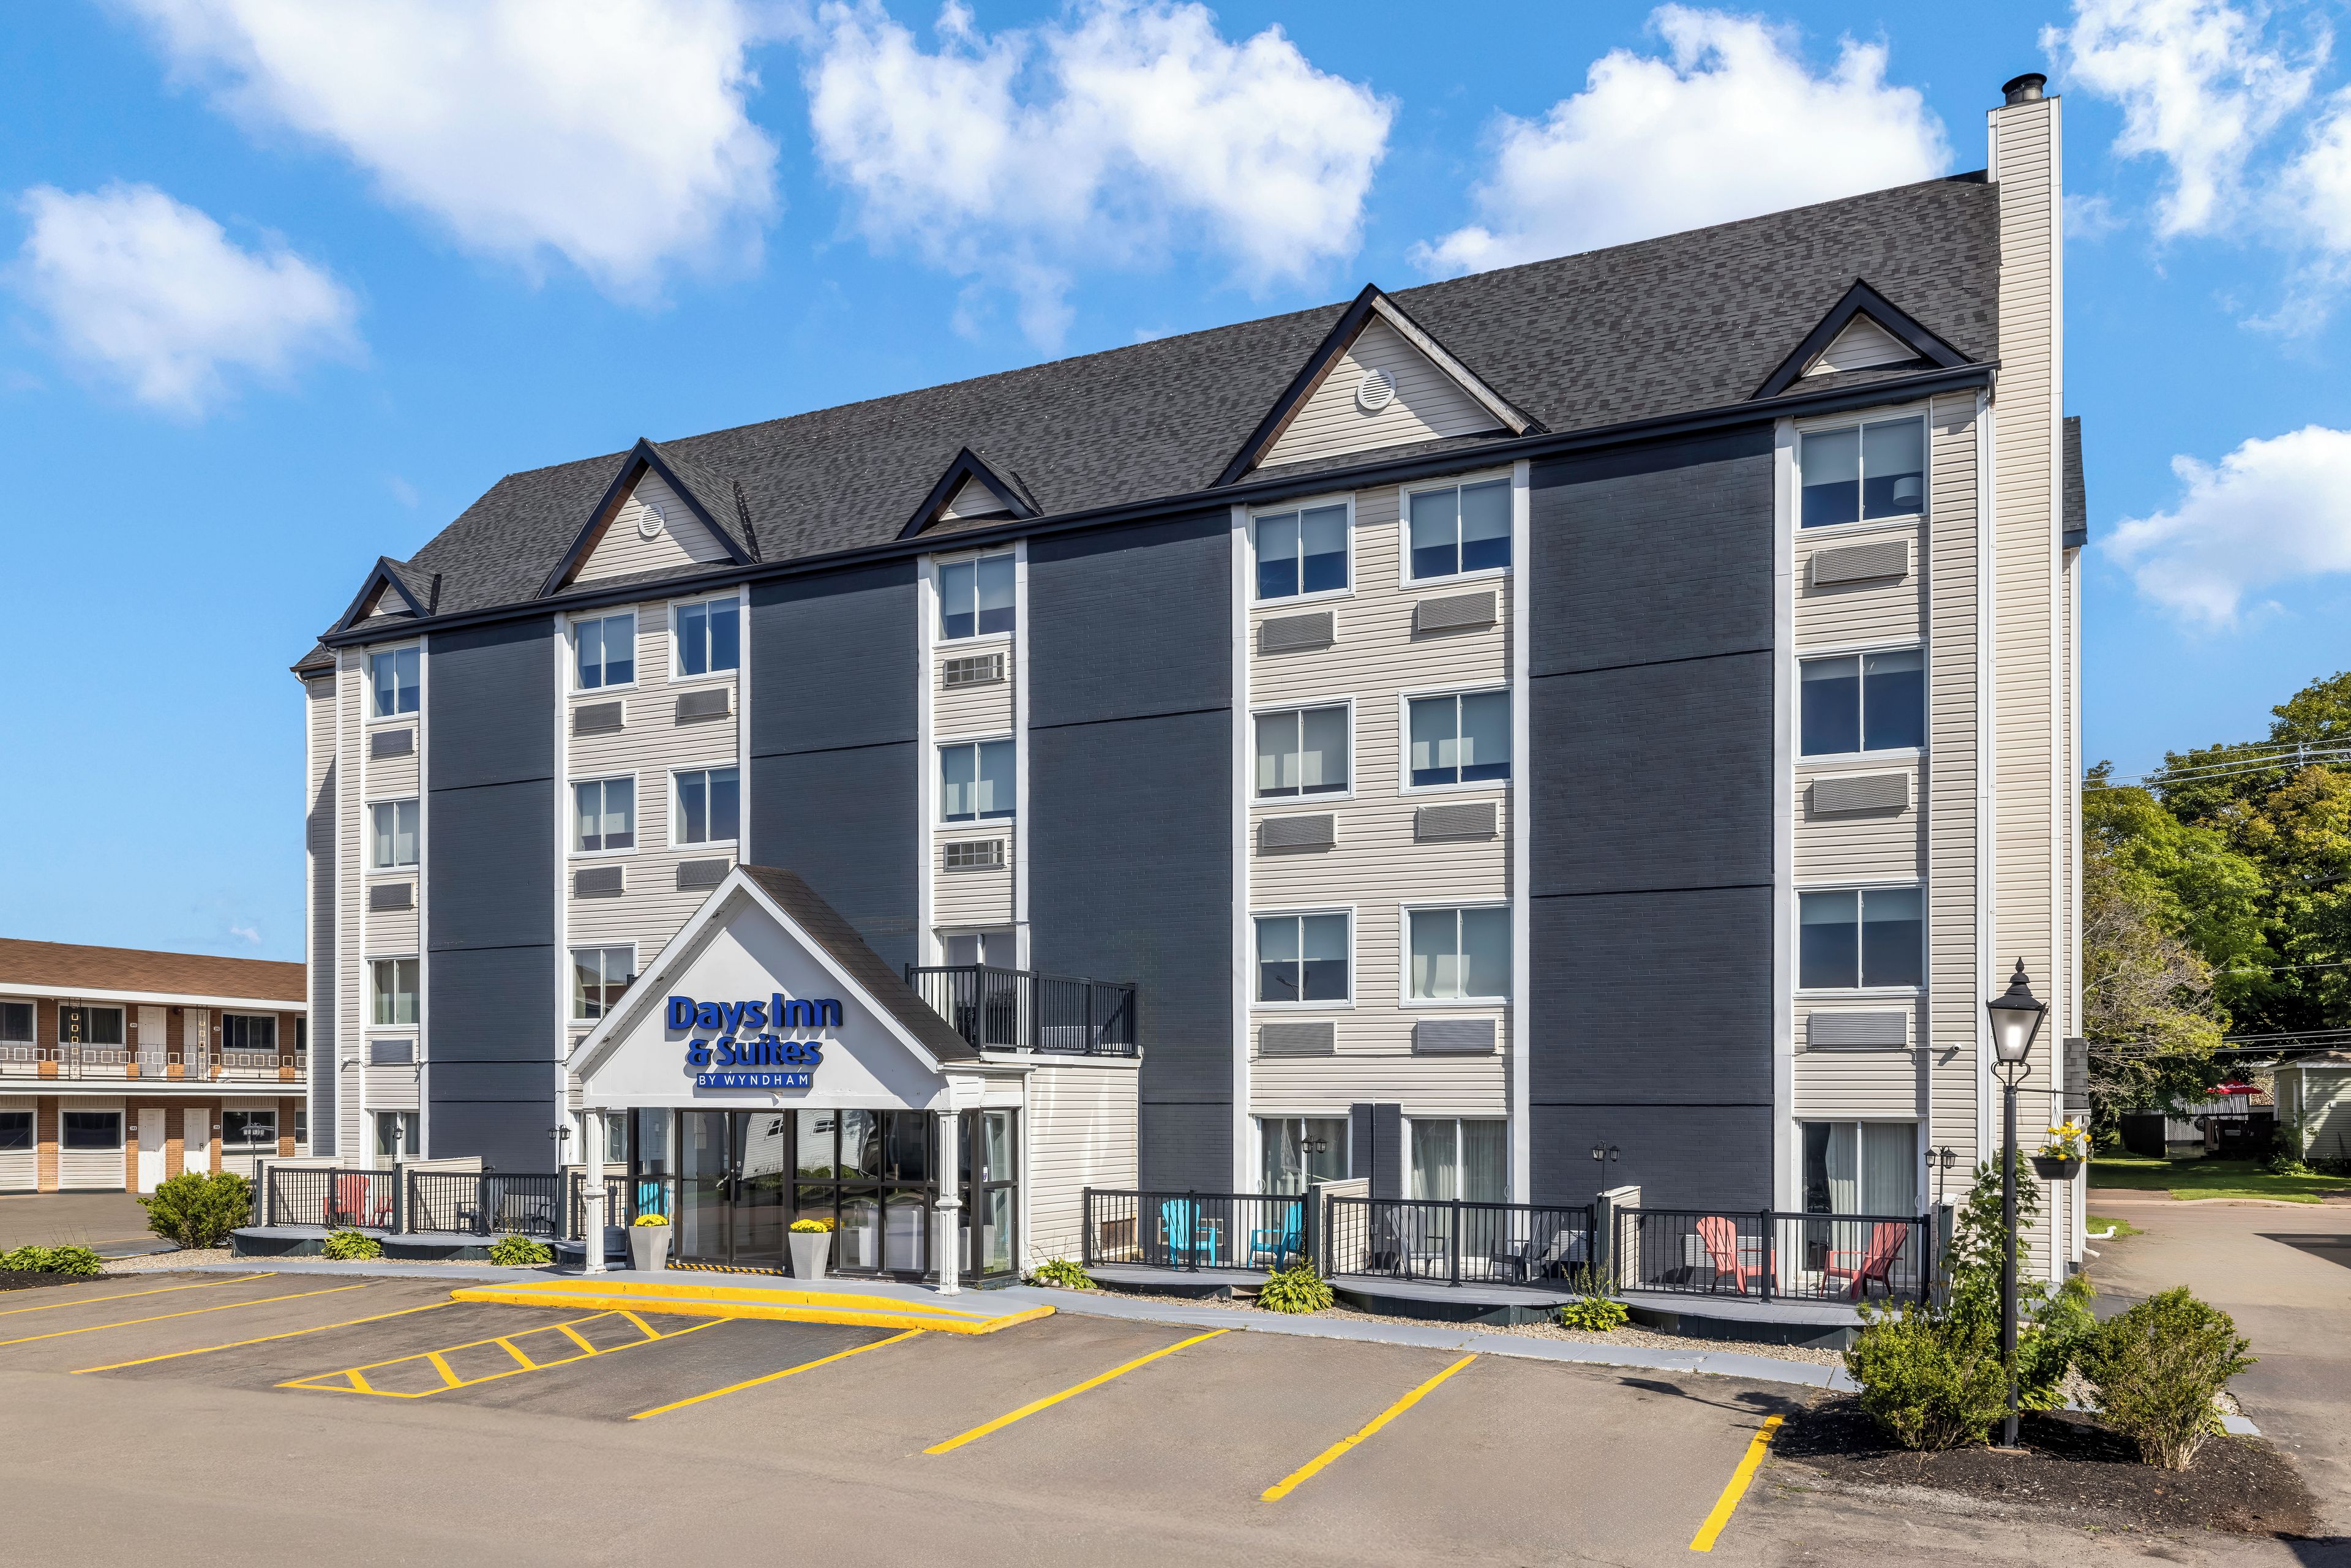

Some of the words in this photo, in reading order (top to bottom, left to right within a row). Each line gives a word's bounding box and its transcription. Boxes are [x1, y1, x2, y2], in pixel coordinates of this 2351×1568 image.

[668, 996, 767, 1034] Days
[772, 993, 843, 1027] Inn
[688, 1039, 711, 1065] &
[716, 1033, 822, 1066] Suites
[699, 1075, 716, 1085] BY
[724, 1075, 808, 1085] WYNDHAM
